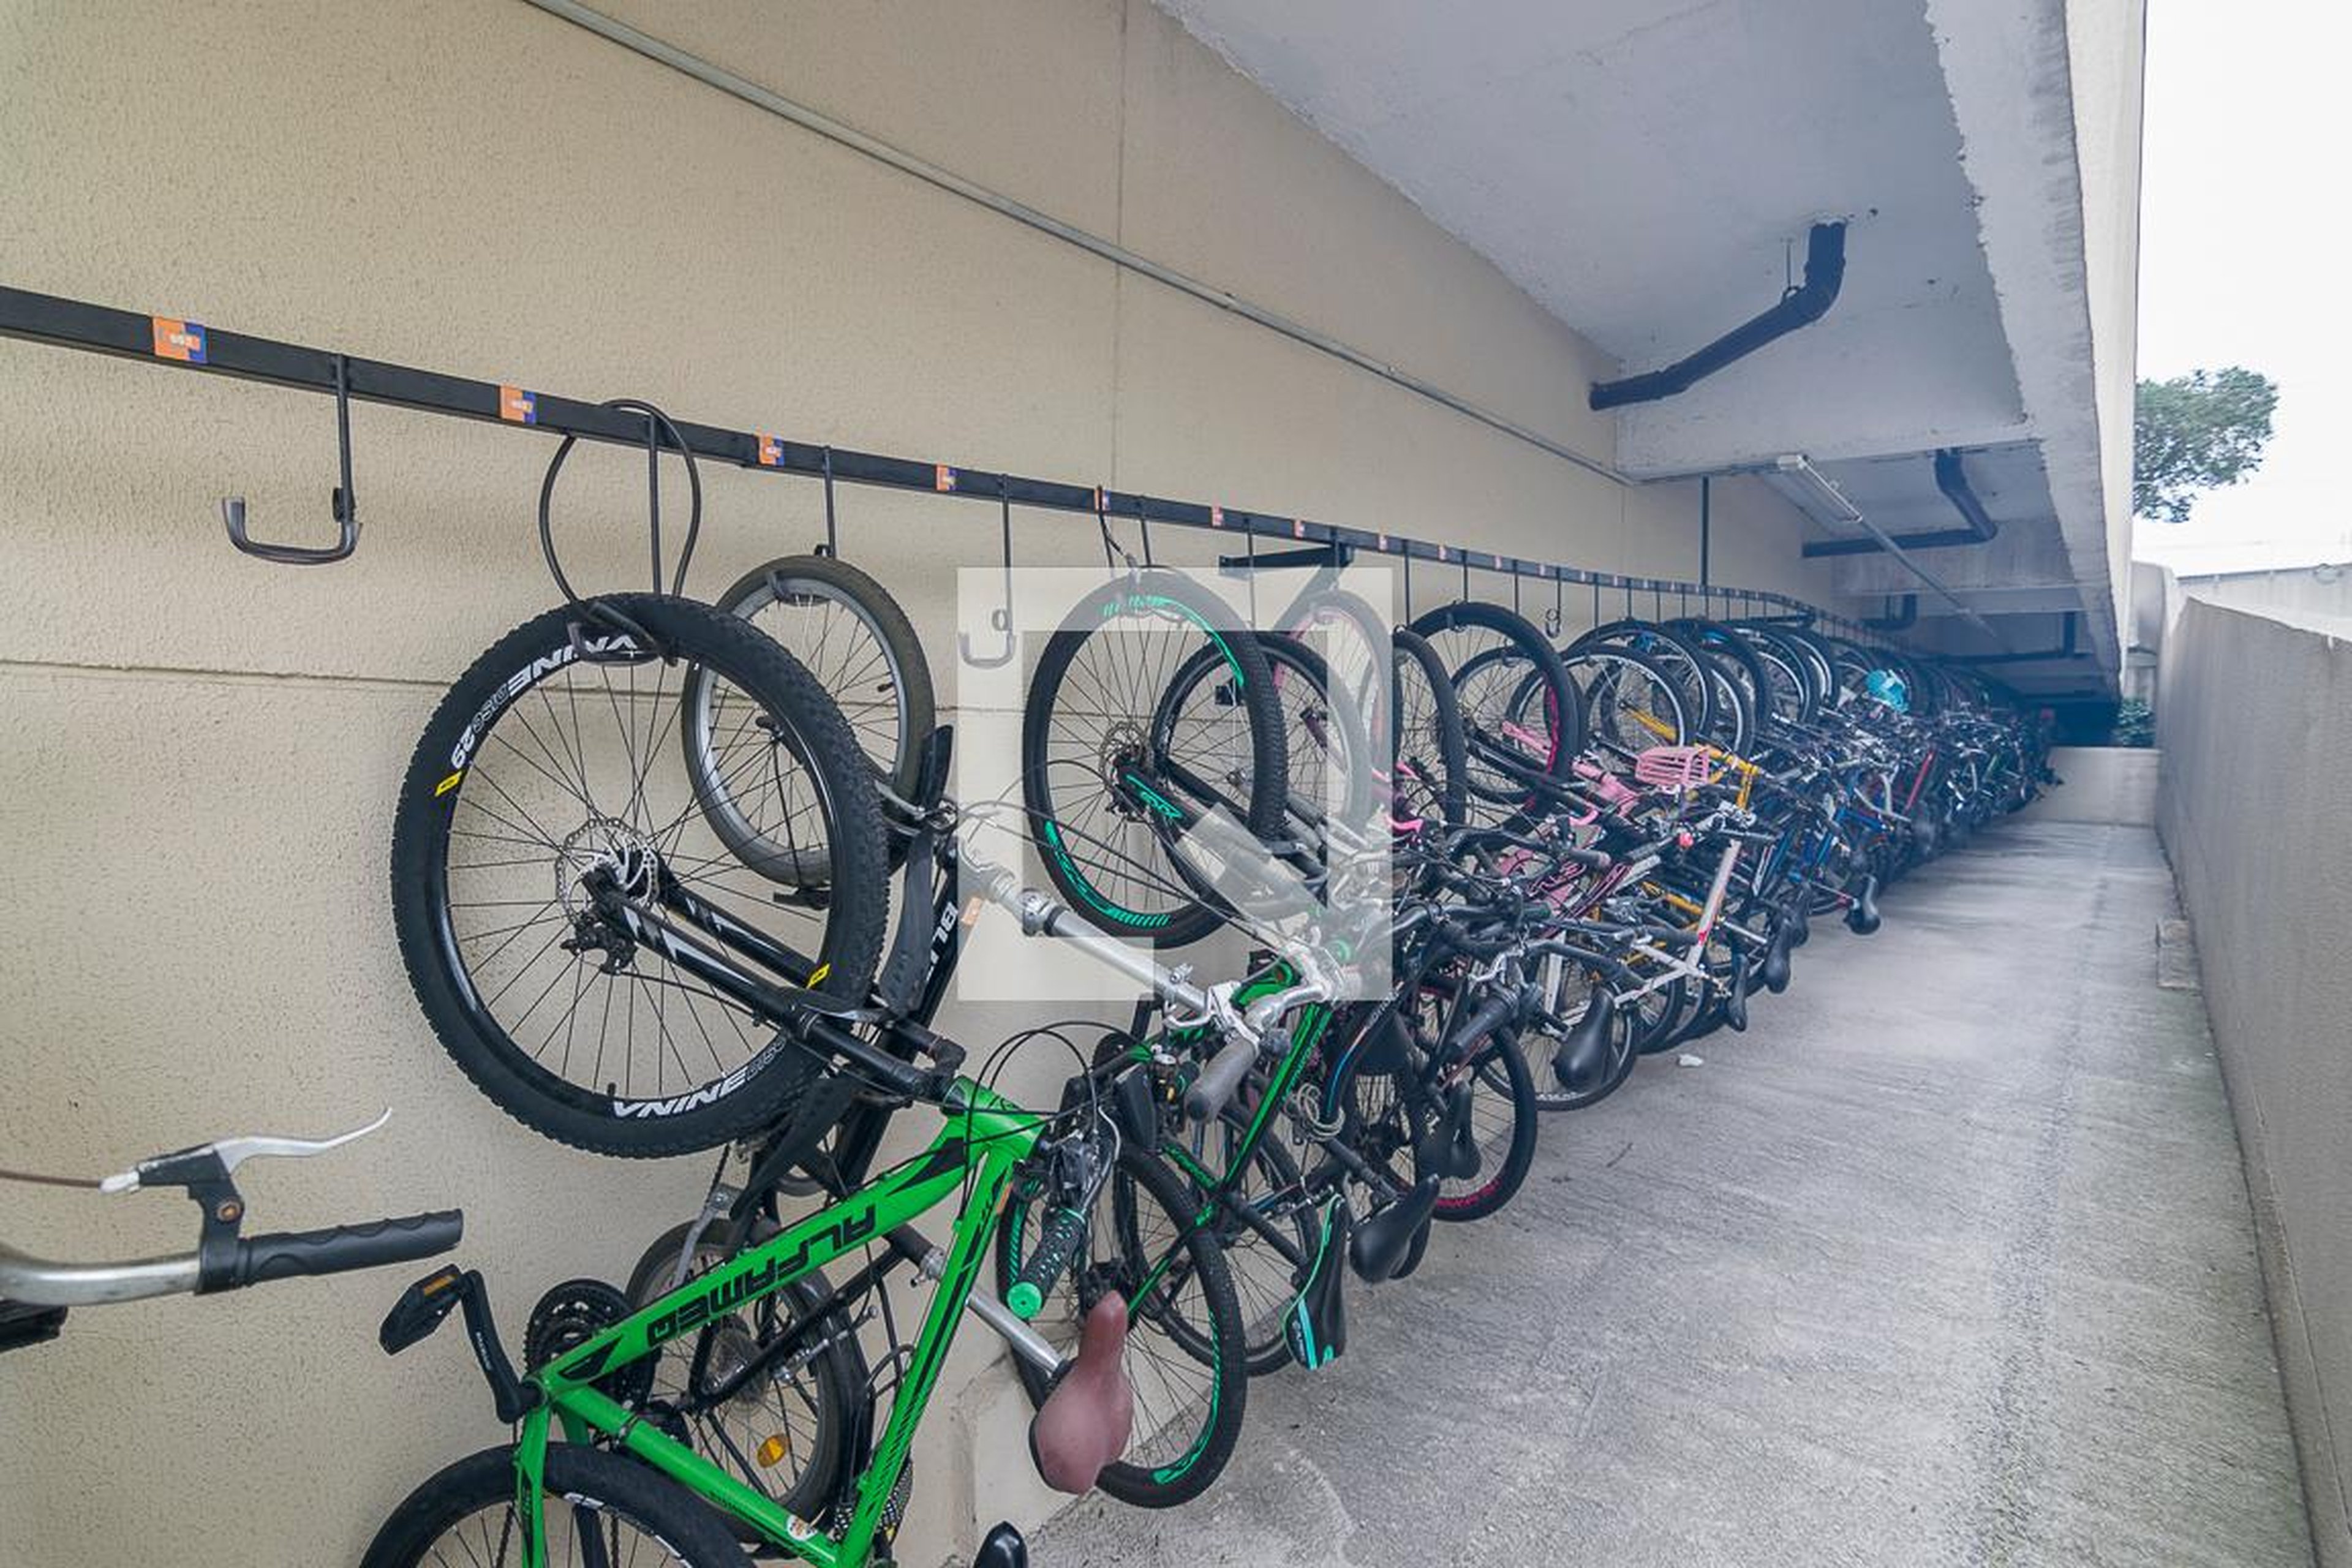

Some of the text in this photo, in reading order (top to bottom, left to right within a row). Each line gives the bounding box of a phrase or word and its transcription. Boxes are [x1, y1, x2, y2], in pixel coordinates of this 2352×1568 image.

[451, 725, 475, 769] 29
[613, 1066, 748, 1118] VNINE
[647, 1205, 876, 1348] ALFAMEQ
